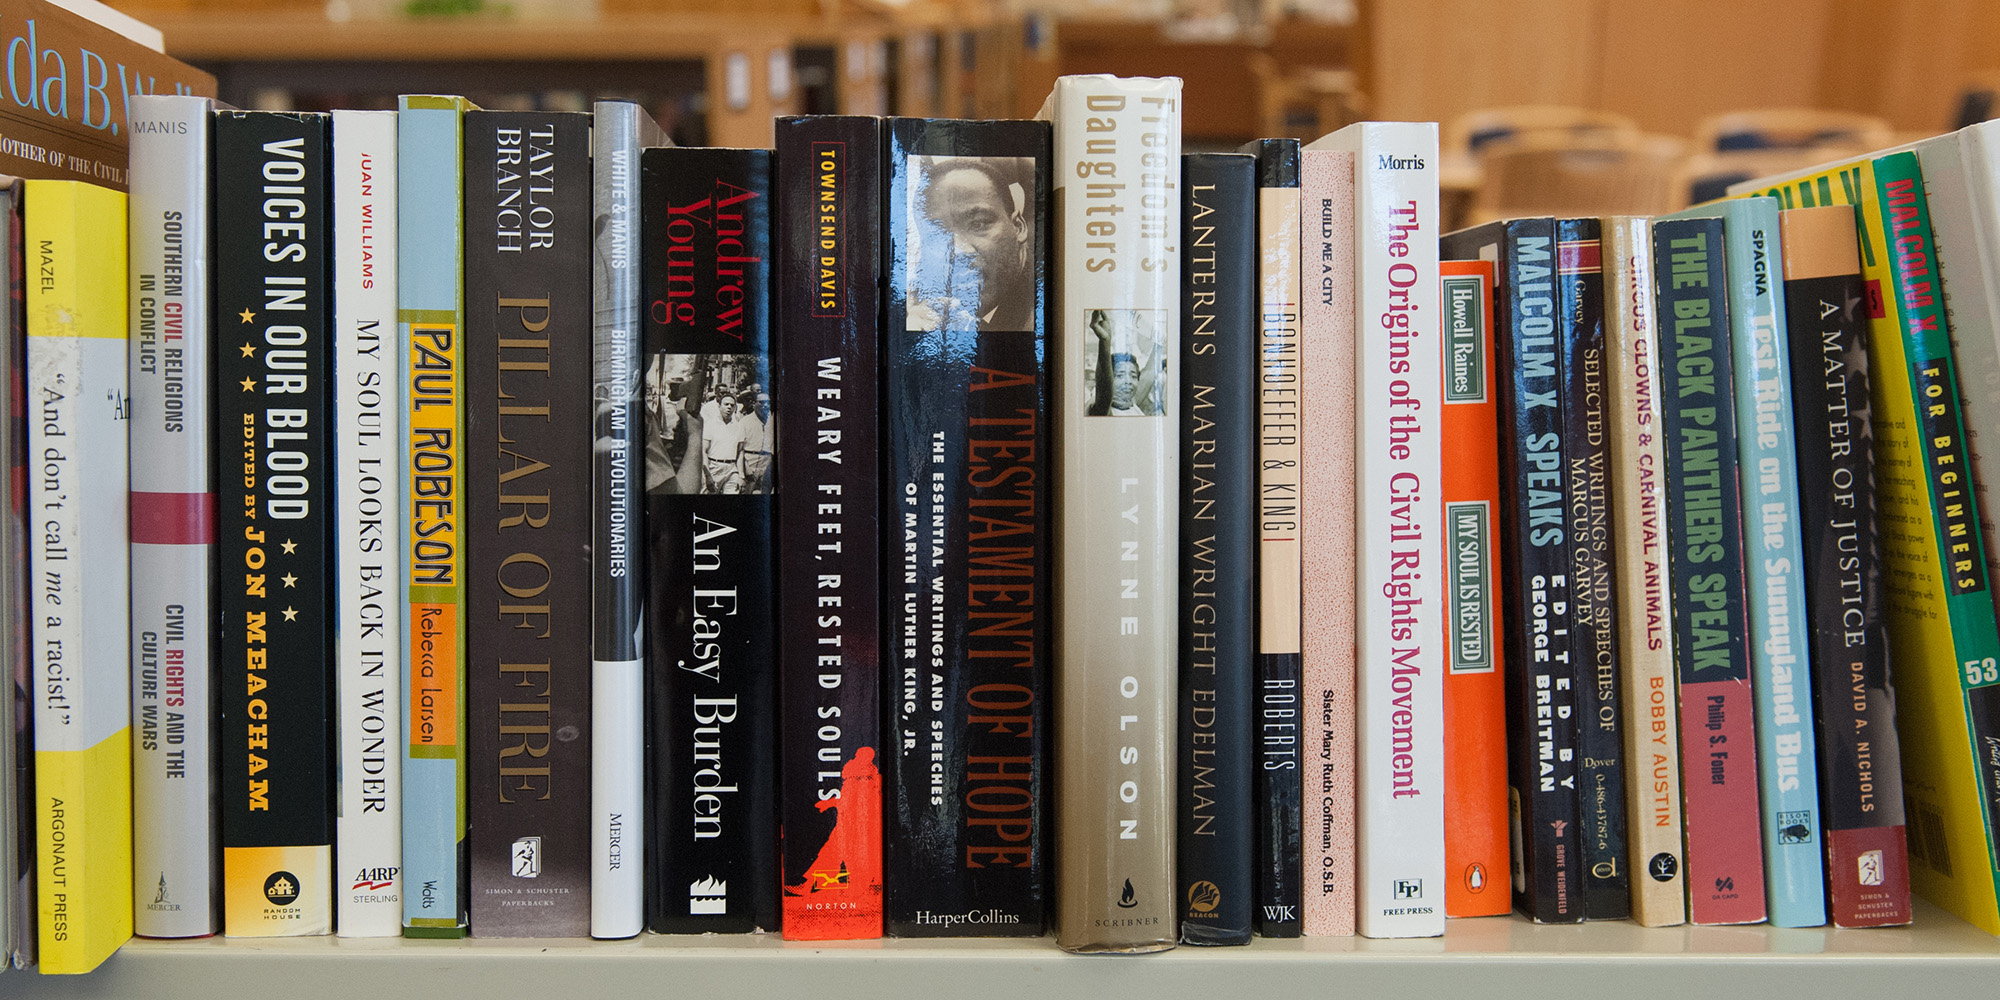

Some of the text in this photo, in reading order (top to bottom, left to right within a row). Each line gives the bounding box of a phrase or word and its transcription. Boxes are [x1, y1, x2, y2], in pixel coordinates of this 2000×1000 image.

[80, 48, 118, 136] B.
[134, 121, 188, 135] MANIS
[49, 150, 91, 175] OF THE
[496, 127, 522, 254] BRANCH
[529, 124, 555, 250] TAYLOR
[1076, 94, 1127, 274] Daughters
[1378, 154, 1425, 171] Morris
[39, 240, 56, 295] MAZEL
[361, 204, 374, 290] WILLIAMS
[651, 194, 712, 327] Young
[716, 177, 762, 343] Andrew
[820, 150, 836, 310] TOWNSEND DAVIS
[1752, 229, 1768, 297] SPAGNA
[139, 274, 157, 375] IN CONFLICT
[163, 210, 184, 433] SOUTHERN CIVIL RELIGIONS
[262, 138, 309, 519] VOICES IN OUR BLOOD
[610, 150, 627, 577] WHITE MANIS BIRMINGHAM REVOLUTIONARIES
[1452, 288, 1474, 394] Howell Raines
[1574, 280, 1588, 324] Garvey
[1516, 236, 1564, 548] MALCOLM X SPEAKS
[1885, 178, 1976, 589] MALCOLM FOR BEGINNERS
[412, 328, 455, 585] PAUL ROBESON
[1191, 184, 1217, 837] LANTERNS MARIAN WRIGHT EDELMAN
[1262, 483, 1296, 531] KING
[1381, 200, 1423, 799] The Origins the Civil Rights Movement
[1670, 232, 1731, 672] THE BLACK PANTHERS SPEAK
[45, 519, 69, 562] call
[357, 319, 387, 815] MY SOUL LOOKS BACK IN WONDER
[497, 291, 552, 804] PILLAR OF FIRE
[817, 356, 842, 802] WEARY RESTED SOULS
[904, 482, 918, 659] OF MARTIN LUTHER
[1457, 514, 1482, 661] MY SOUL RESTED
[1571, 457, 1594, 627] MARCUS GARVEY
[1584, 348, 1615, 732] SELECTED WRITINGS AND SPEECHES OF
[1634, 338, 1670, 827] CLOWNS CARNIVAL ANIMALS BOBBY AUSTIN
[1752, 314, 1800, 794] Test Sunnyland Bus
[1819, 300, 1875, 813] A MATTER OF JUSTICE DAVID NICHOLS
[243, 413, 270, 812] EDITED BY JON MEACHAM
[678, 512, 739, 842] An Easy Burden
[931, 431, 945, 807] THE ESSENTIAL WRITINGS AND SPEECHES
[966, 364, 1036, 869] A TESTAMENT OF HOPE
[1120, 478, 1139, 840] LYNNE OLSON
[1551, 574, 1571, 720] EDITED
[1964, 656, 1999, 685] 53
[141, 631, 158, 751] CULTURE WARS
[165, 604, 185, 780] CIVIL RIGHTS AND THE
[1263, 679, 1296, 771] ROBERTS
[1531, 576, 1555, 793] GEORGE BREITMAN
[1584, 757, 1616, 769] Dover
[1595, 773, 1608, 850] 0-486-43787-6
[51, 797, 68, 942] ARGONAUT PRESS
[352, 894, 398, 903] STERLING
[355, 866, 400, 881] AARP
[609, 812, 622, 871] MERCER
[806, 902, 857, 911] NORTON
[1320, 797, 1334, 897] Coffman, O.S.B.
[1556, 844, 1566, 868] GROVE
[1857, 901, 1894, 910] SCHUSTER
[147, 903, 181, 912] MERCER
[915, 909, 1020, 927] HarperCollins
[1094, 916, 1160, 927] SCRIBNER
[1263, 904, 1296, 922] WJK
[1383, 907, 1433, 917] FREE PRESS
[1854, 911, 1899, 919] PAPERBACKS
